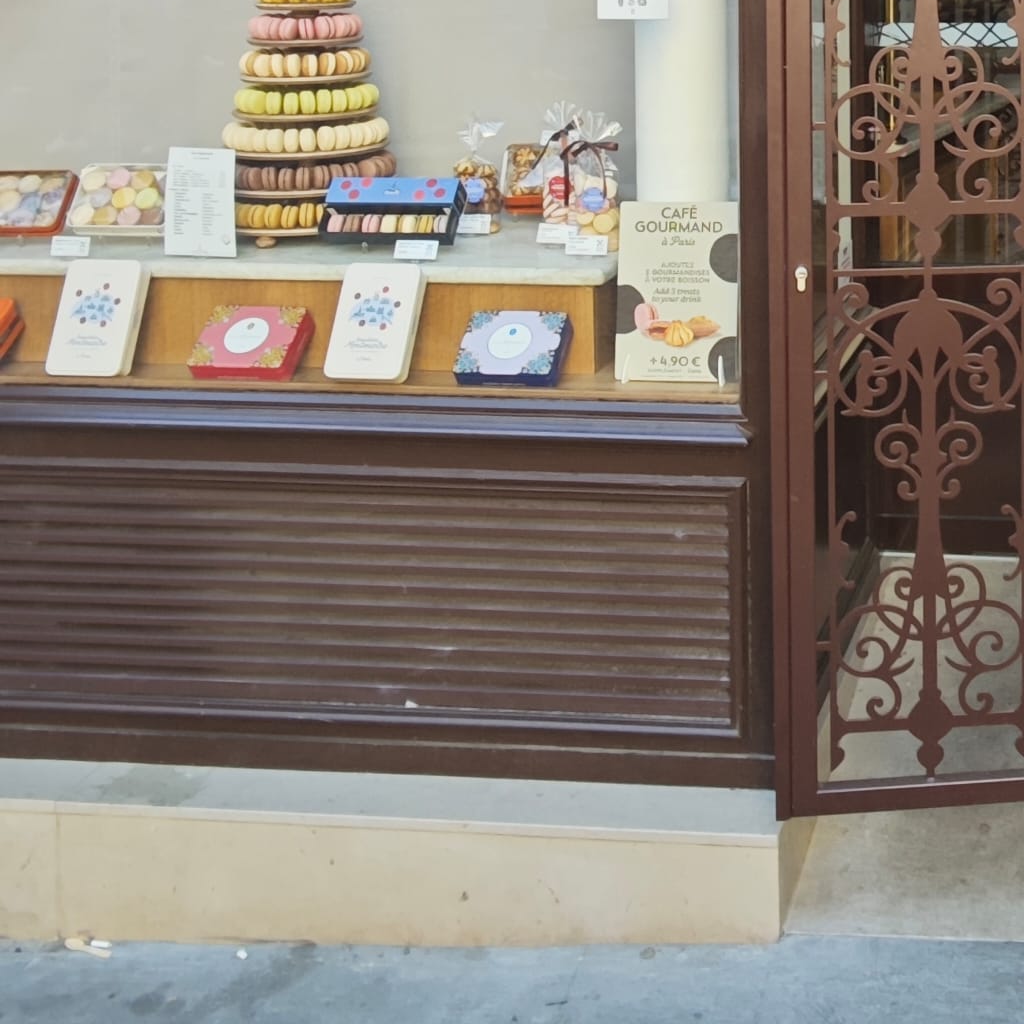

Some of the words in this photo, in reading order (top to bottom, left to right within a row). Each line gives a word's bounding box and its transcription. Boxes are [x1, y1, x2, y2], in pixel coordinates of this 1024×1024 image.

[661, 204, 697, 220] CAFÉ
[634, 220, 723, 233] GOURMAND
[669, 236, 696, 246] Paris
